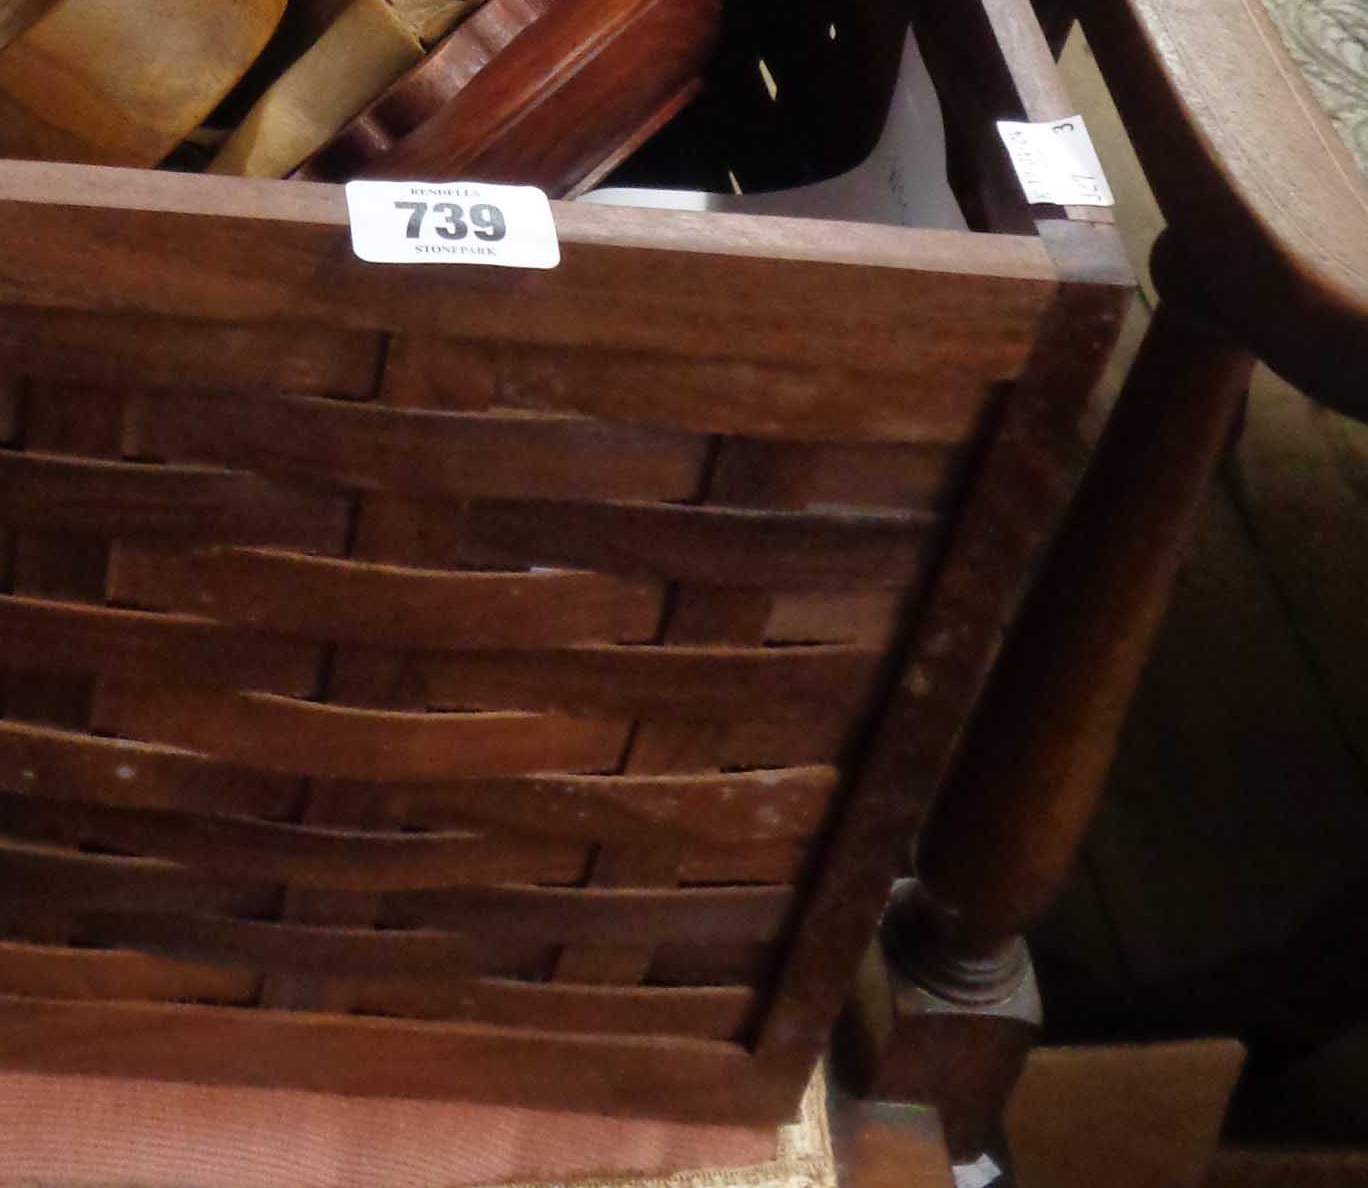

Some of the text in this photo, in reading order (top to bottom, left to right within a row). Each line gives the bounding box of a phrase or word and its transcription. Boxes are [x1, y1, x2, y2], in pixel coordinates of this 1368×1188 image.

[410, 187, 481, 198] RENDELLS
[393, 200, 507, 242] 739
[415, 245, 497, 257] STONEPARK
